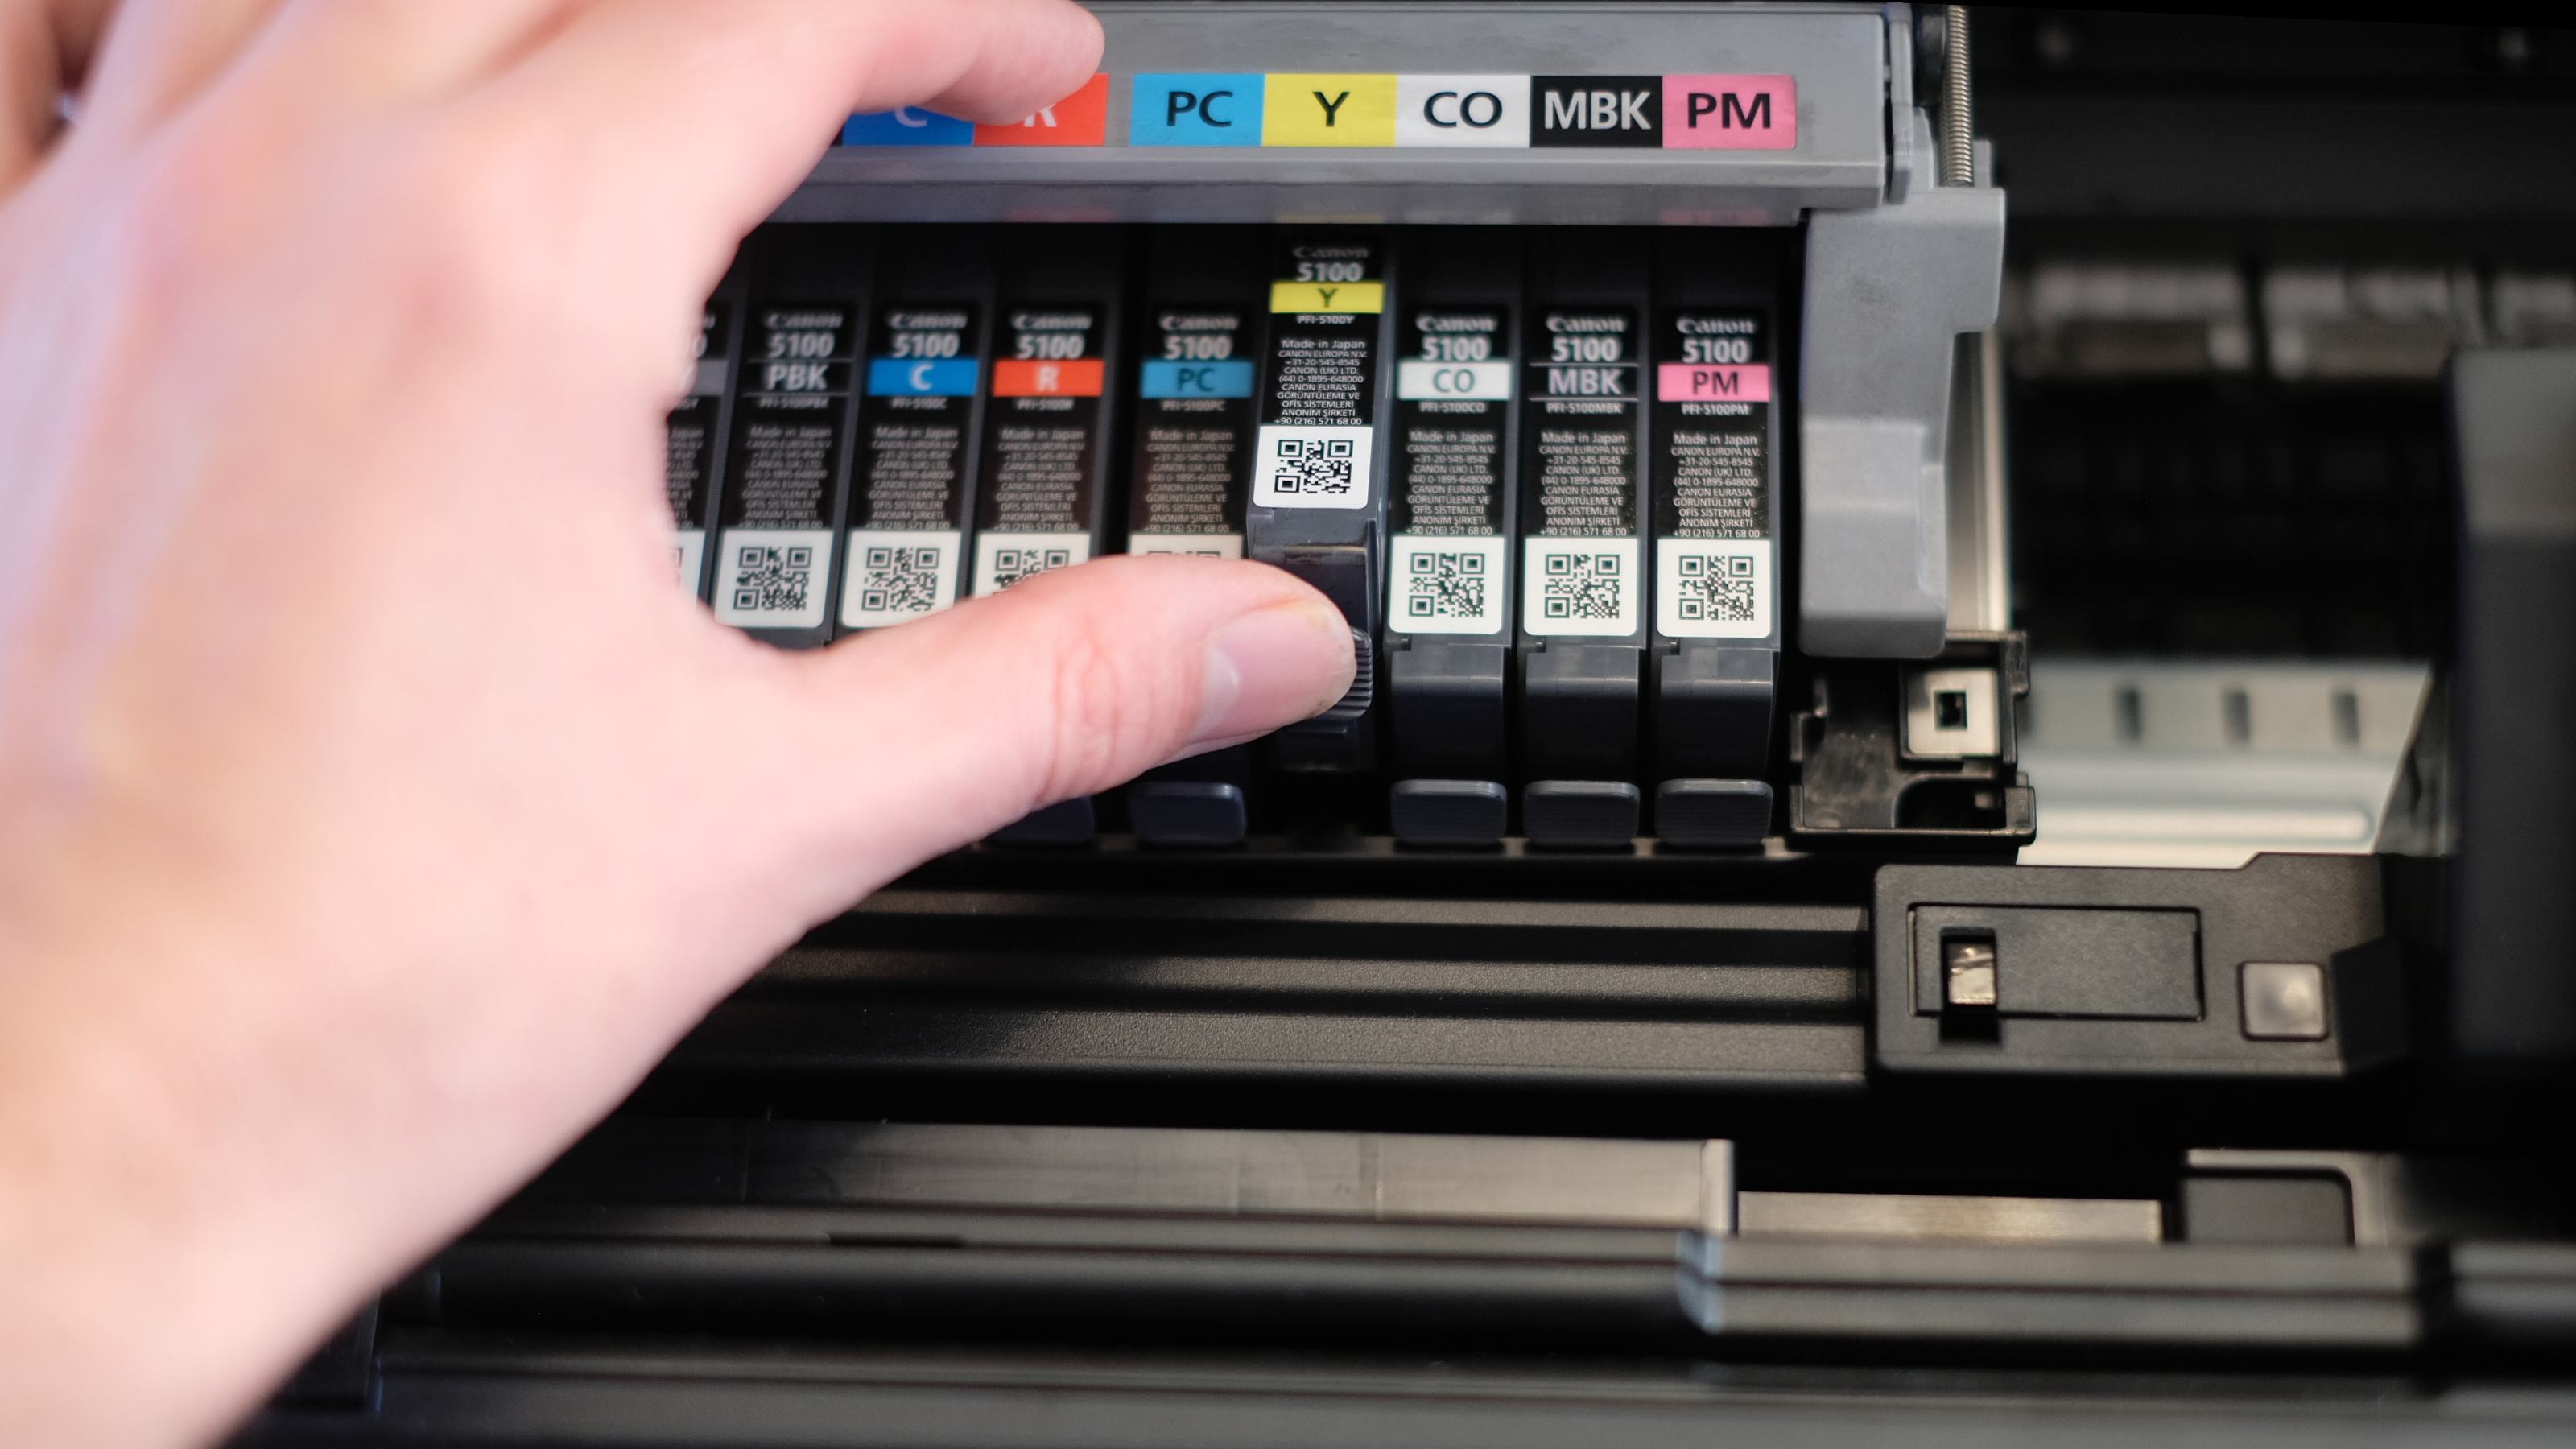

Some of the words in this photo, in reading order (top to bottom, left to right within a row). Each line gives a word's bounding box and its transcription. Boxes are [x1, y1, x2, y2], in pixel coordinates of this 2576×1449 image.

[1166, 91, 1233, 127] PC
[1312, 91, 1349, 127] Y
[1424, 91, 1503, 128] CO
[1545, 91, 1650, 130] MBK
[1688, 93, 1770, 129] PM
[1294, 247, 1368, 258] Canon
[1297, 262, 1363, 282] 5100
[1318, 288, 1338, 308] Y
[1013, 315, 1092, 329] Canon
[1160, 316, 1237, 329] Canon
[1298, 316, 1354, 324] PFI-5100Y
[1416, 316, 1496, 332] Canon
[1546, 316, 1625, 332] Canon
[1677, 318, 1756, 333] Canon
[769, 332, 834, 357] 5100
[893, 333, 959, 358] 5100
[1017, 336, 1084, 359] 5100
[1165, 336, 1231, 359] 5100
[1282, 340, 1315, 349] Made
[1319, 340, 1328, 349] in
[1332, 340, 1365, 350] Japan
[1422, 336, 1488, 361] 5100
[1552, 337, 1618, 361] 5100
[1682, 339, 1748, 363] 5100
[768, 365, 828, 390] PBK
[910, 364, 933, 391] C
[1038, 366, 1058, 391] R
[1178, 368, 1214, 391] PC
[1433, 369, 1475, 393] CO
[1550, 369, 1621, 394] MBK
[1693, 371, 1738, 394] PM
[1421, 402, 1485, 411] PFI-5100CO
[1547, 403, 1621, 413] PFI-5100MBK
[1682, 404, 1748, 415] PFI-5100PM
[1150, 431, 1183, 440] Made
[1187, 431, 1196, 440] in
[1200, 431, 1232, 442] Japan
[1410, 432, 1443, 442] Made
[1447, 432, 1456, 442] in
[1461, 432, 1493, 444] Japan
[1542, 433, 1575, 443] Made
[1579, 433, 1588, 443] in
[1592, 433, 1625, 444] Japan
[1674, 434, 1707, 444] Made
[1711, 434, 1720, 444] in
[1724, 435, 1757, 446] Japan
[1407, 445, 1440, 453] CANON
[1443, 445, 1477, 453] EUROPA
[1480, 445, 1495, 453] N.V.
[1671, 448, 1704, 456] CANON
[1707, 448, 1742, 456] EUROPA
[1744, 448, 1760, 456] N.V.
[1414, 455, 1488, 463] +31-20-545-8545
[1414, 465, 1447, 473] CANON
[1450, 465, 1468, 473] (UK)
[1470, 465, 1488, 473] LTD.
[1546, 466, 1579, 474] CANON
[1583, 466, 1600, 474] (UK)
[1603, 466, 1620, 474] LTD.
[1678, 468, 1711, 476] CANON
[1715, 468, 1732, 476] (UK)
[1735, 468, 1752, 476] LTD.
[1409, 475, 1425, 483] (44)
[1428, 475, 1492, 483] 0-1895-648000
[1542, 477, 1558, 485] (44)
[1561, 477, 1625, 485] 0-1895-648000
[1674, 478, 1690, 486] (44)
[1693, 478, 1758, 486] 0-1895-648000
[1413, 485, 1445, 493] CANON
[1546, 486, 1579, 494] CANON
[1678, 488, 1711, 496] CANON
[1479, 496, 1489, 504] VE
[1612, 497, 1623, 505] VE
[1745, 499, 1756, 507] VE
[1406, 526, 1423, 535] +90
[1426, 526, 1447, 535] (216)
[1450, 526, 1464, 535] 571
[1468, 526, 1479, 535] 68
[1481, 526, 1492, 535] 00
